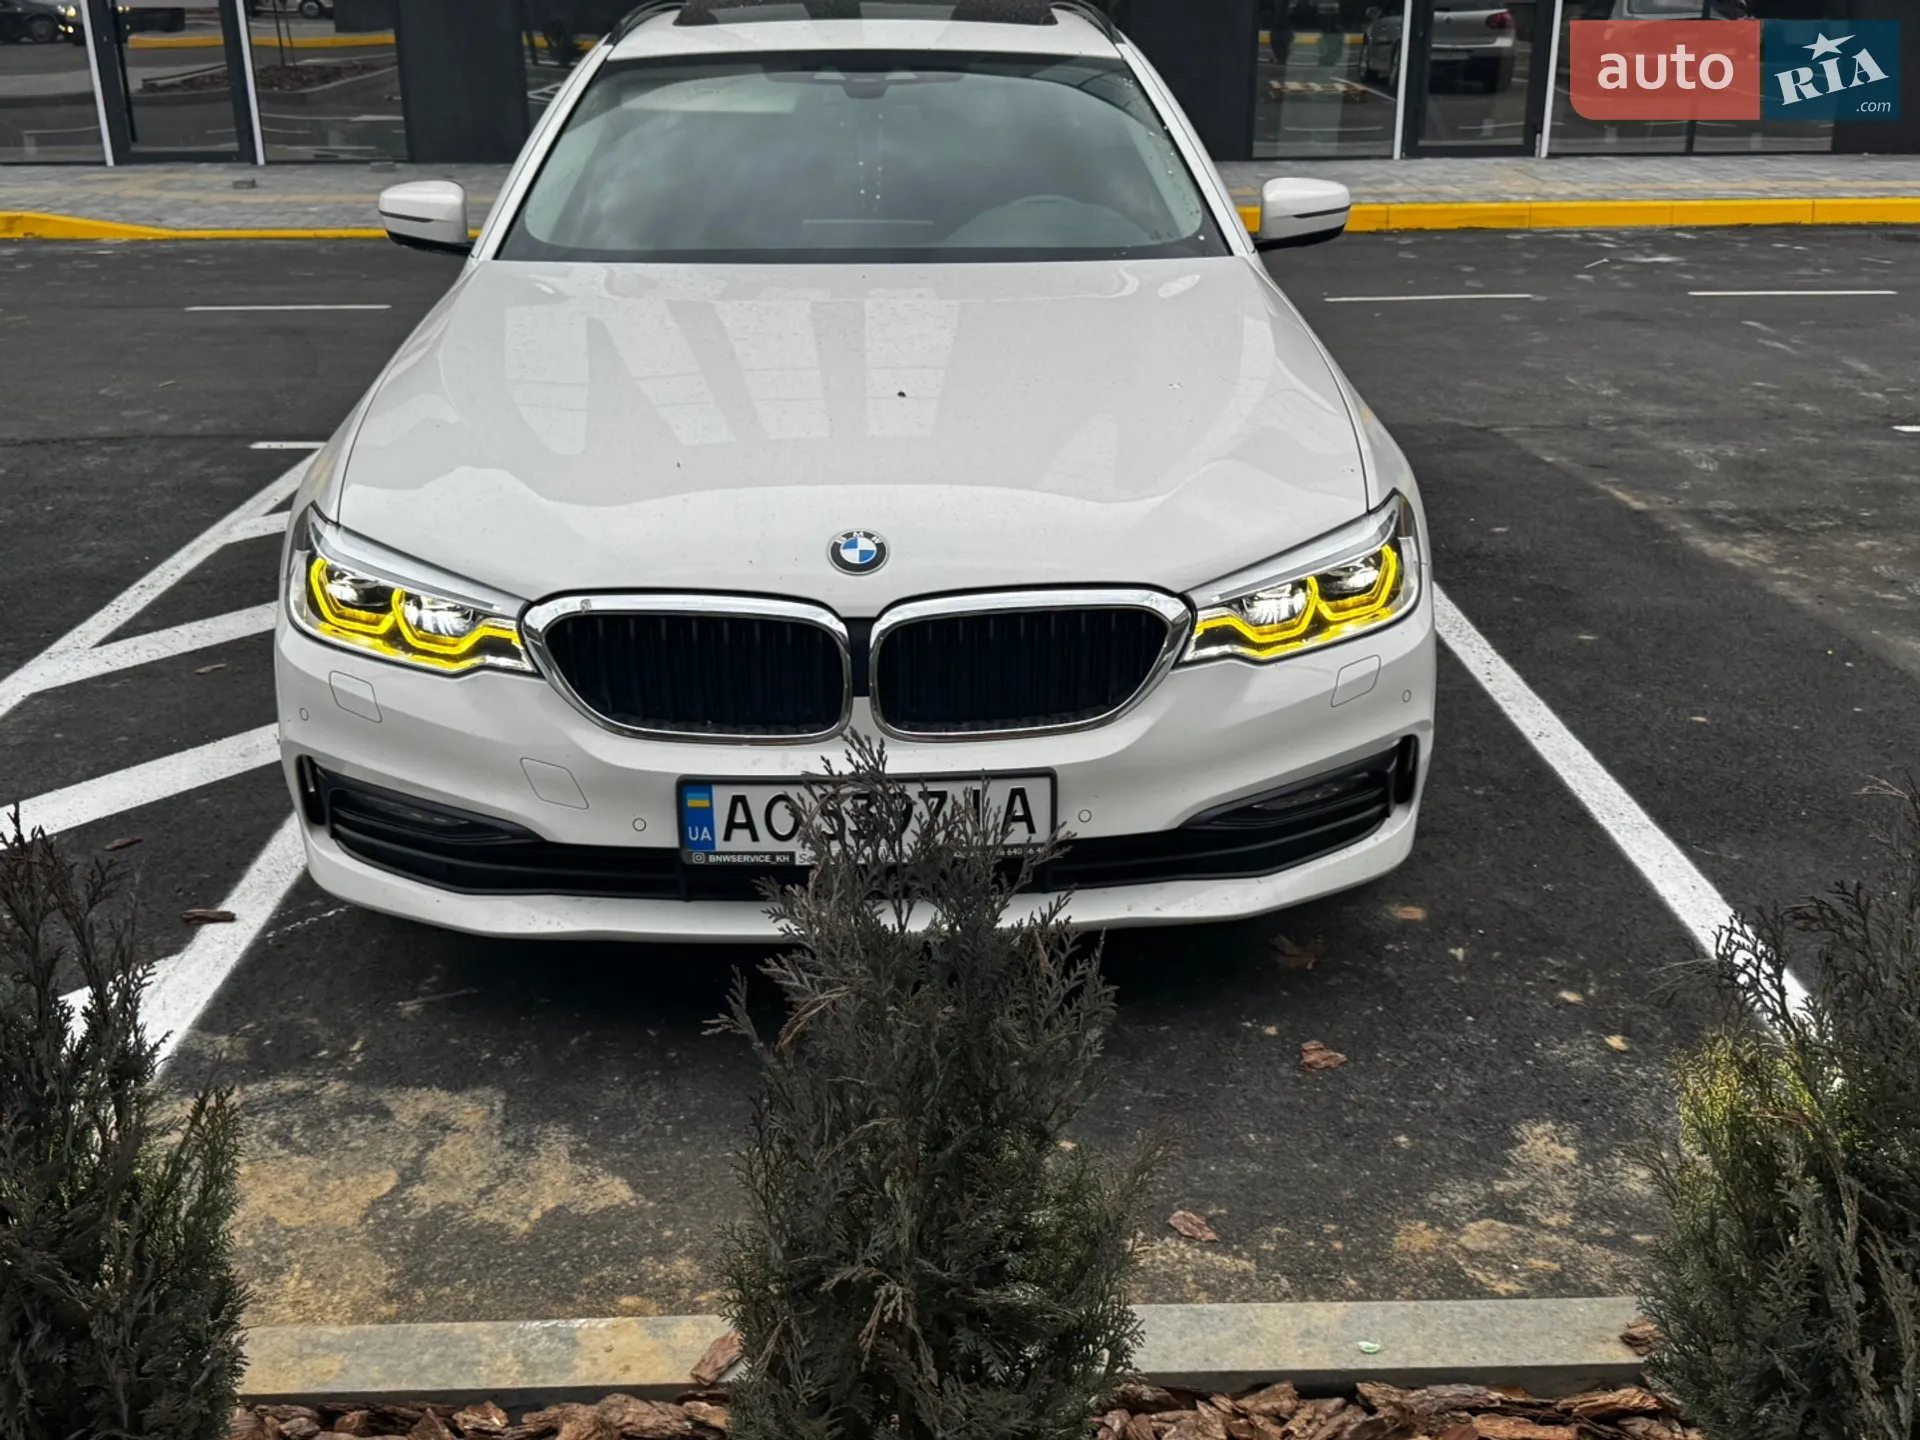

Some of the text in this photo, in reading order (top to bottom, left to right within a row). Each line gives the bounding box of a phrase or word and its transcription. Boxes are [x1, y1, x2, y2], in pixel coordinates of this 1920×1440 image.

[835, 531, 883, 544] BMW
[722, 792, 802, 842] AO
[687, 826, 712, 841] UA
